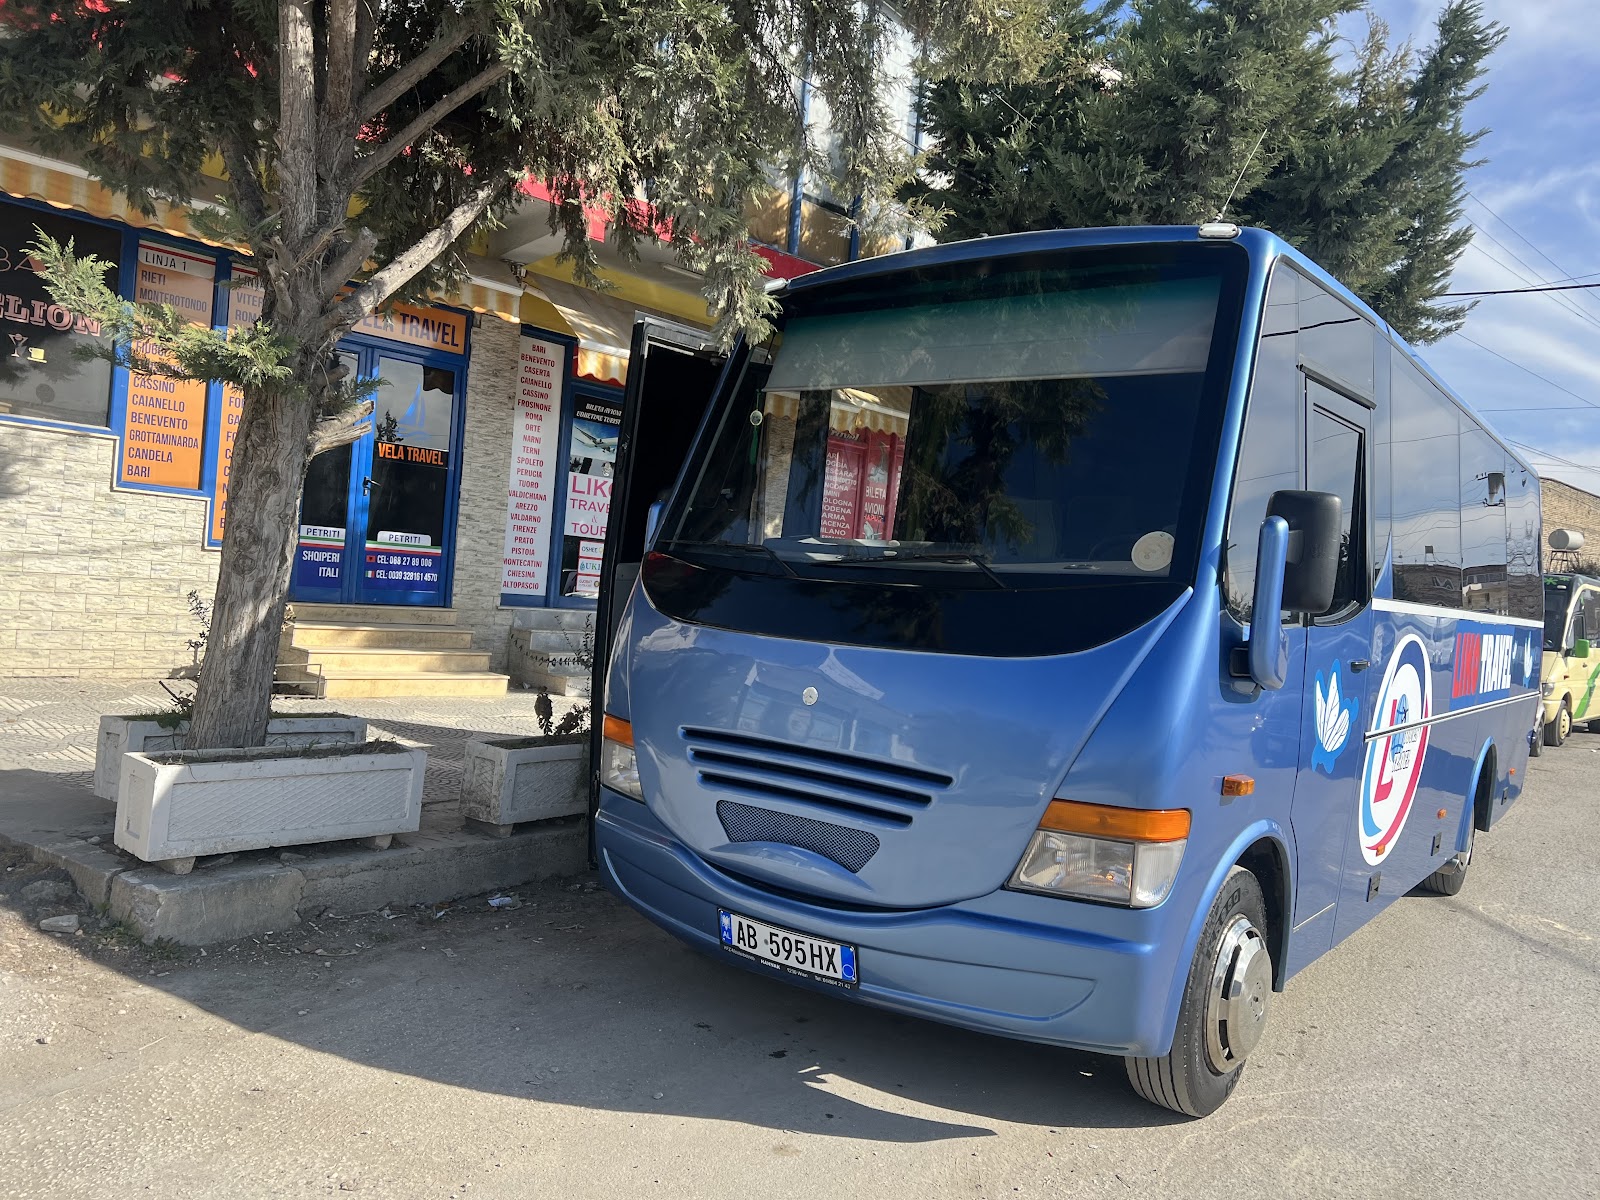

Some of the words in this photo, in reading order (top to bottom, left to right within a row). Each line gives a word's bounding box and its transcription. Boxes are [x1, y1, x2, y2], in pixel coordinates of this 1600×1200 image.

[145, 251, 176, 269] LINJA
[182, 261, 187, 272] 1
[141, 269, 166, 286] RIETI
[139, 286, 208, 313] MONTEROTONDO
[0, 292, 101, 337] LION
[400, 312, 459, 348] TRAVEL
[532, 344, 546, 354] BARI
[520, 353, 555, 368] BENEVENTO
[524, 365, 551, 378] CASERTA
[133, 375, 175, 394] CASSINO
[520, 376, 552, 390] CAIANELLO
[522, 388, 549, 401] CASSINO
[131, 393, 186, 413] CAIANELLO
[517, 398, 552, 412] FROSINONE
[130, 411, 188, 431] BENEVENTO
[525, 411, 543, 422] ROMA
[525, 423, 541, 433] ORTE
[129, 429, 199, 449] GROTTAMINARDA
[522, 434, 542, 445] NARNI
[128, 446, 173, 464] CANDELA
[378, 442, 404, 461] VELA
[406, 446, 444, 466] TRAVEL
[522, 445, 540, 456] TERNI
[516, 456, 544, 468] SPOLETO
[127, 464, 151, 478] BARI
[518, 479, 539, 490] TUORO
[508, 489, 547, 501] VALDICHIANA
[866, 486, 886, 500] BILETA
[515, 501, 538, 512] AREZZO
[864, 502, 885, 516] AVIONI
[510, 512, 541, 523] VALDARNO
[306, 528, 340, 538] PETRITI
[512, 524, 537, 534] FIRENZE
[388, 534, 421, 544] PETRITI
[514, 535, 534, 545] PRATO
[302, 550, 340, 563] SHQIPERI
[511, 547, 535, 556] PISTOIA
[377, 555, 389, 564] CEL:
[402, 556, 410, 566] 27
[411, 557, 420, 567] 89
[503, 557, 542, 568] MONTECATINI
[318, 566, 339, 578] ITALI
[375, 569, 388, 579] CEL:
[507, 569, 536, 578] CHIESINA
[502, 580, 539, 590] ALTOPASCIO
[1452, 632, 1480, 699] LIKO
[1479, 634, 1513, 694] TRAVEL
[737, 920, 758, 950] AB
[769, 931, 838, 974] 595HX
